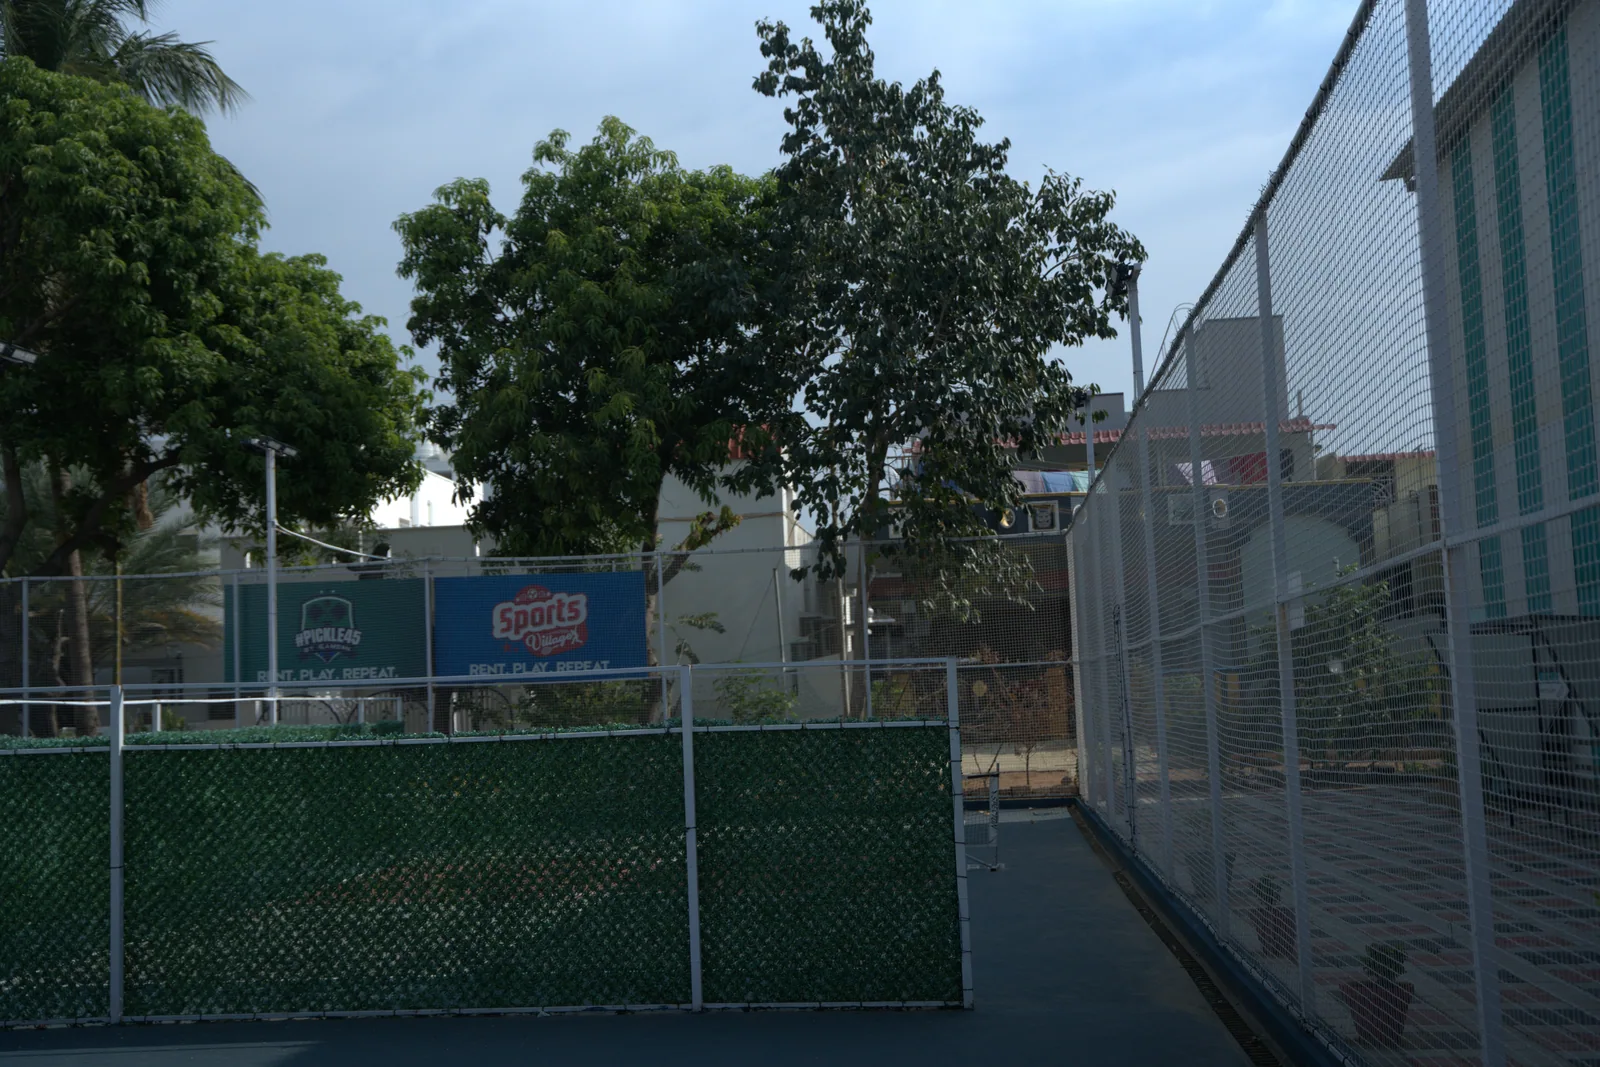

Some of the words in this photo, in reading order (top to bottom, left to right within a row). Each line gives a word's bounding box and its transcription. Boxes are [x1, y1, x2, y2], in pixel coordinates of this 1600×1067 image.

[500, 598, 581, 637] Sports
[295, 627, 362, 647] #PICKLE45
[526, 631, 573, 651] Village
[300, 668, 339, 681] PLAY.
[342, 666, 399, 679] REPEAT.
